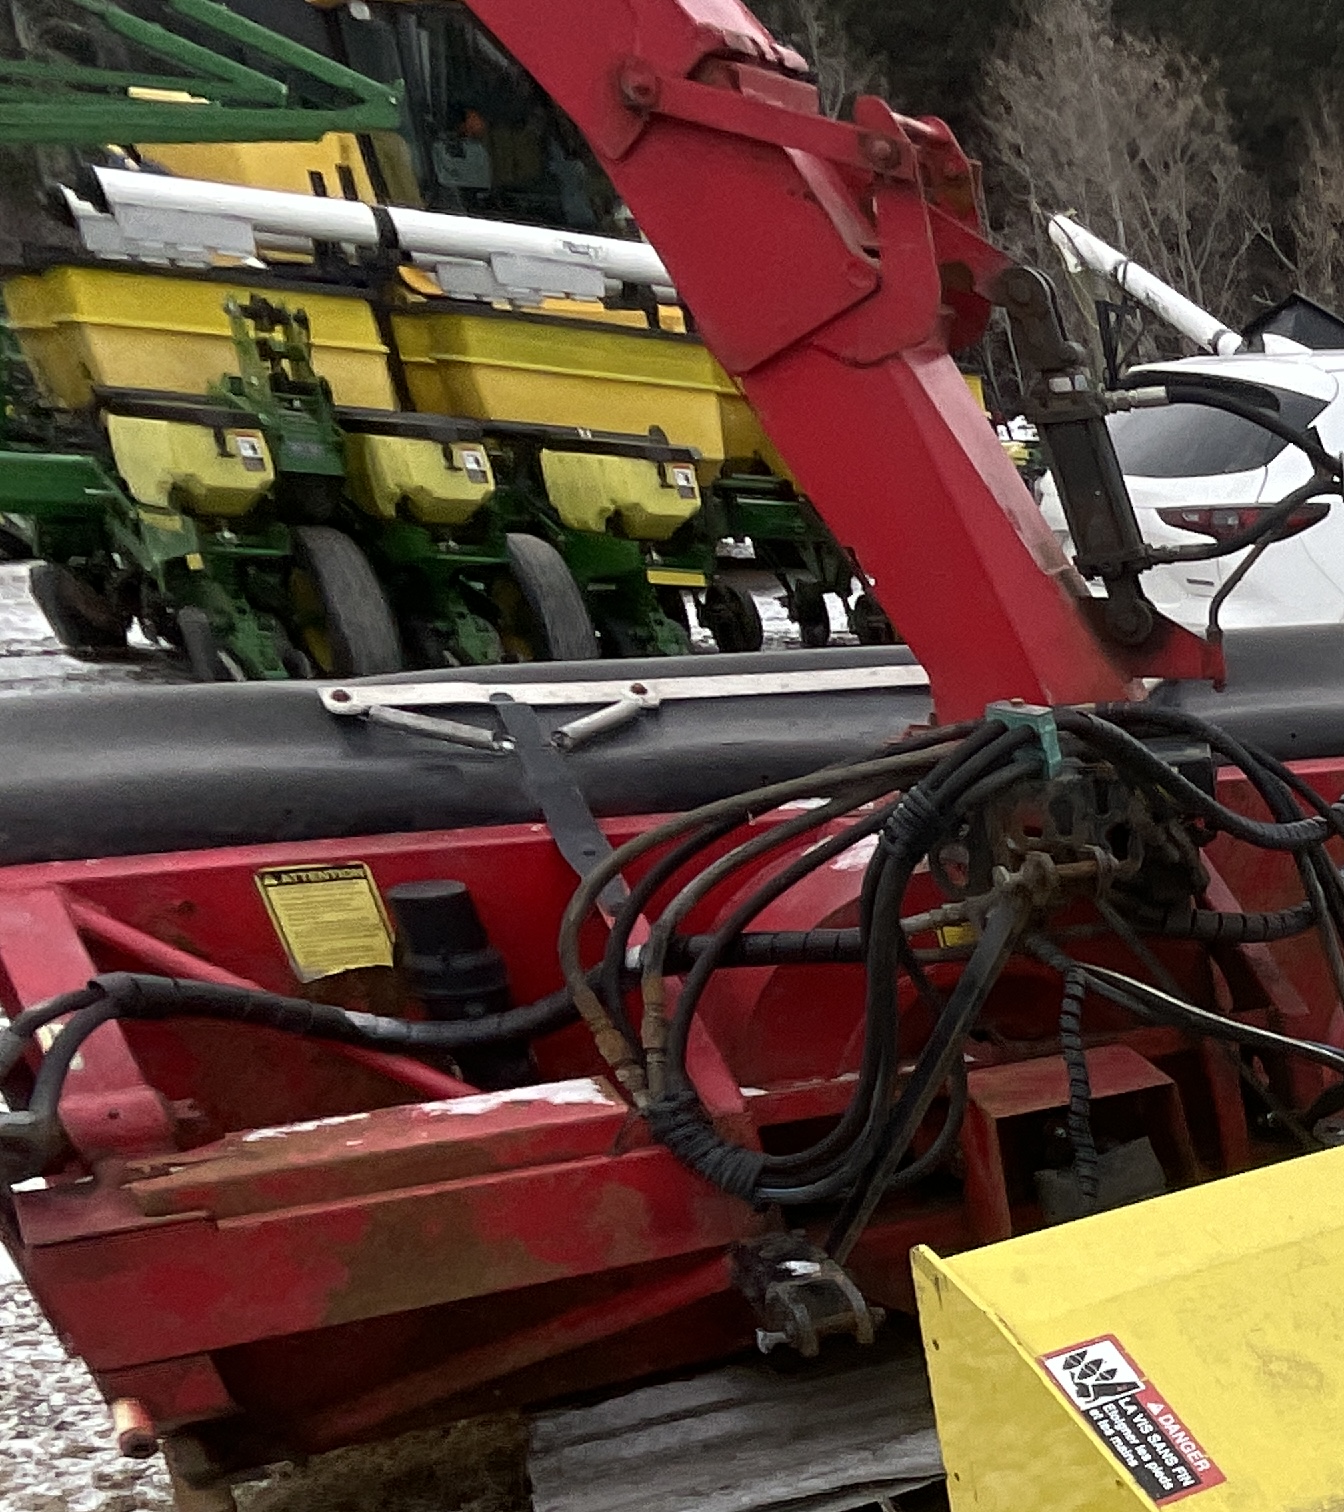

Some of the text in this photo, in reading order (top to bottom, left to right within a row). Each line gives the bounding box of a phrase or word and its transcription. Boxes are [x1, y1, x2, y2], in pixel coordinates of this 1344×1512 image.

[1118, 1397, 1195, 1488] LA VIS SANS FIN
[1134, 1443, 1153, 1462] les
[1145, 1460, 1174, 1491] pieds
[1158, 1413, 1210, 1472] DANGER
